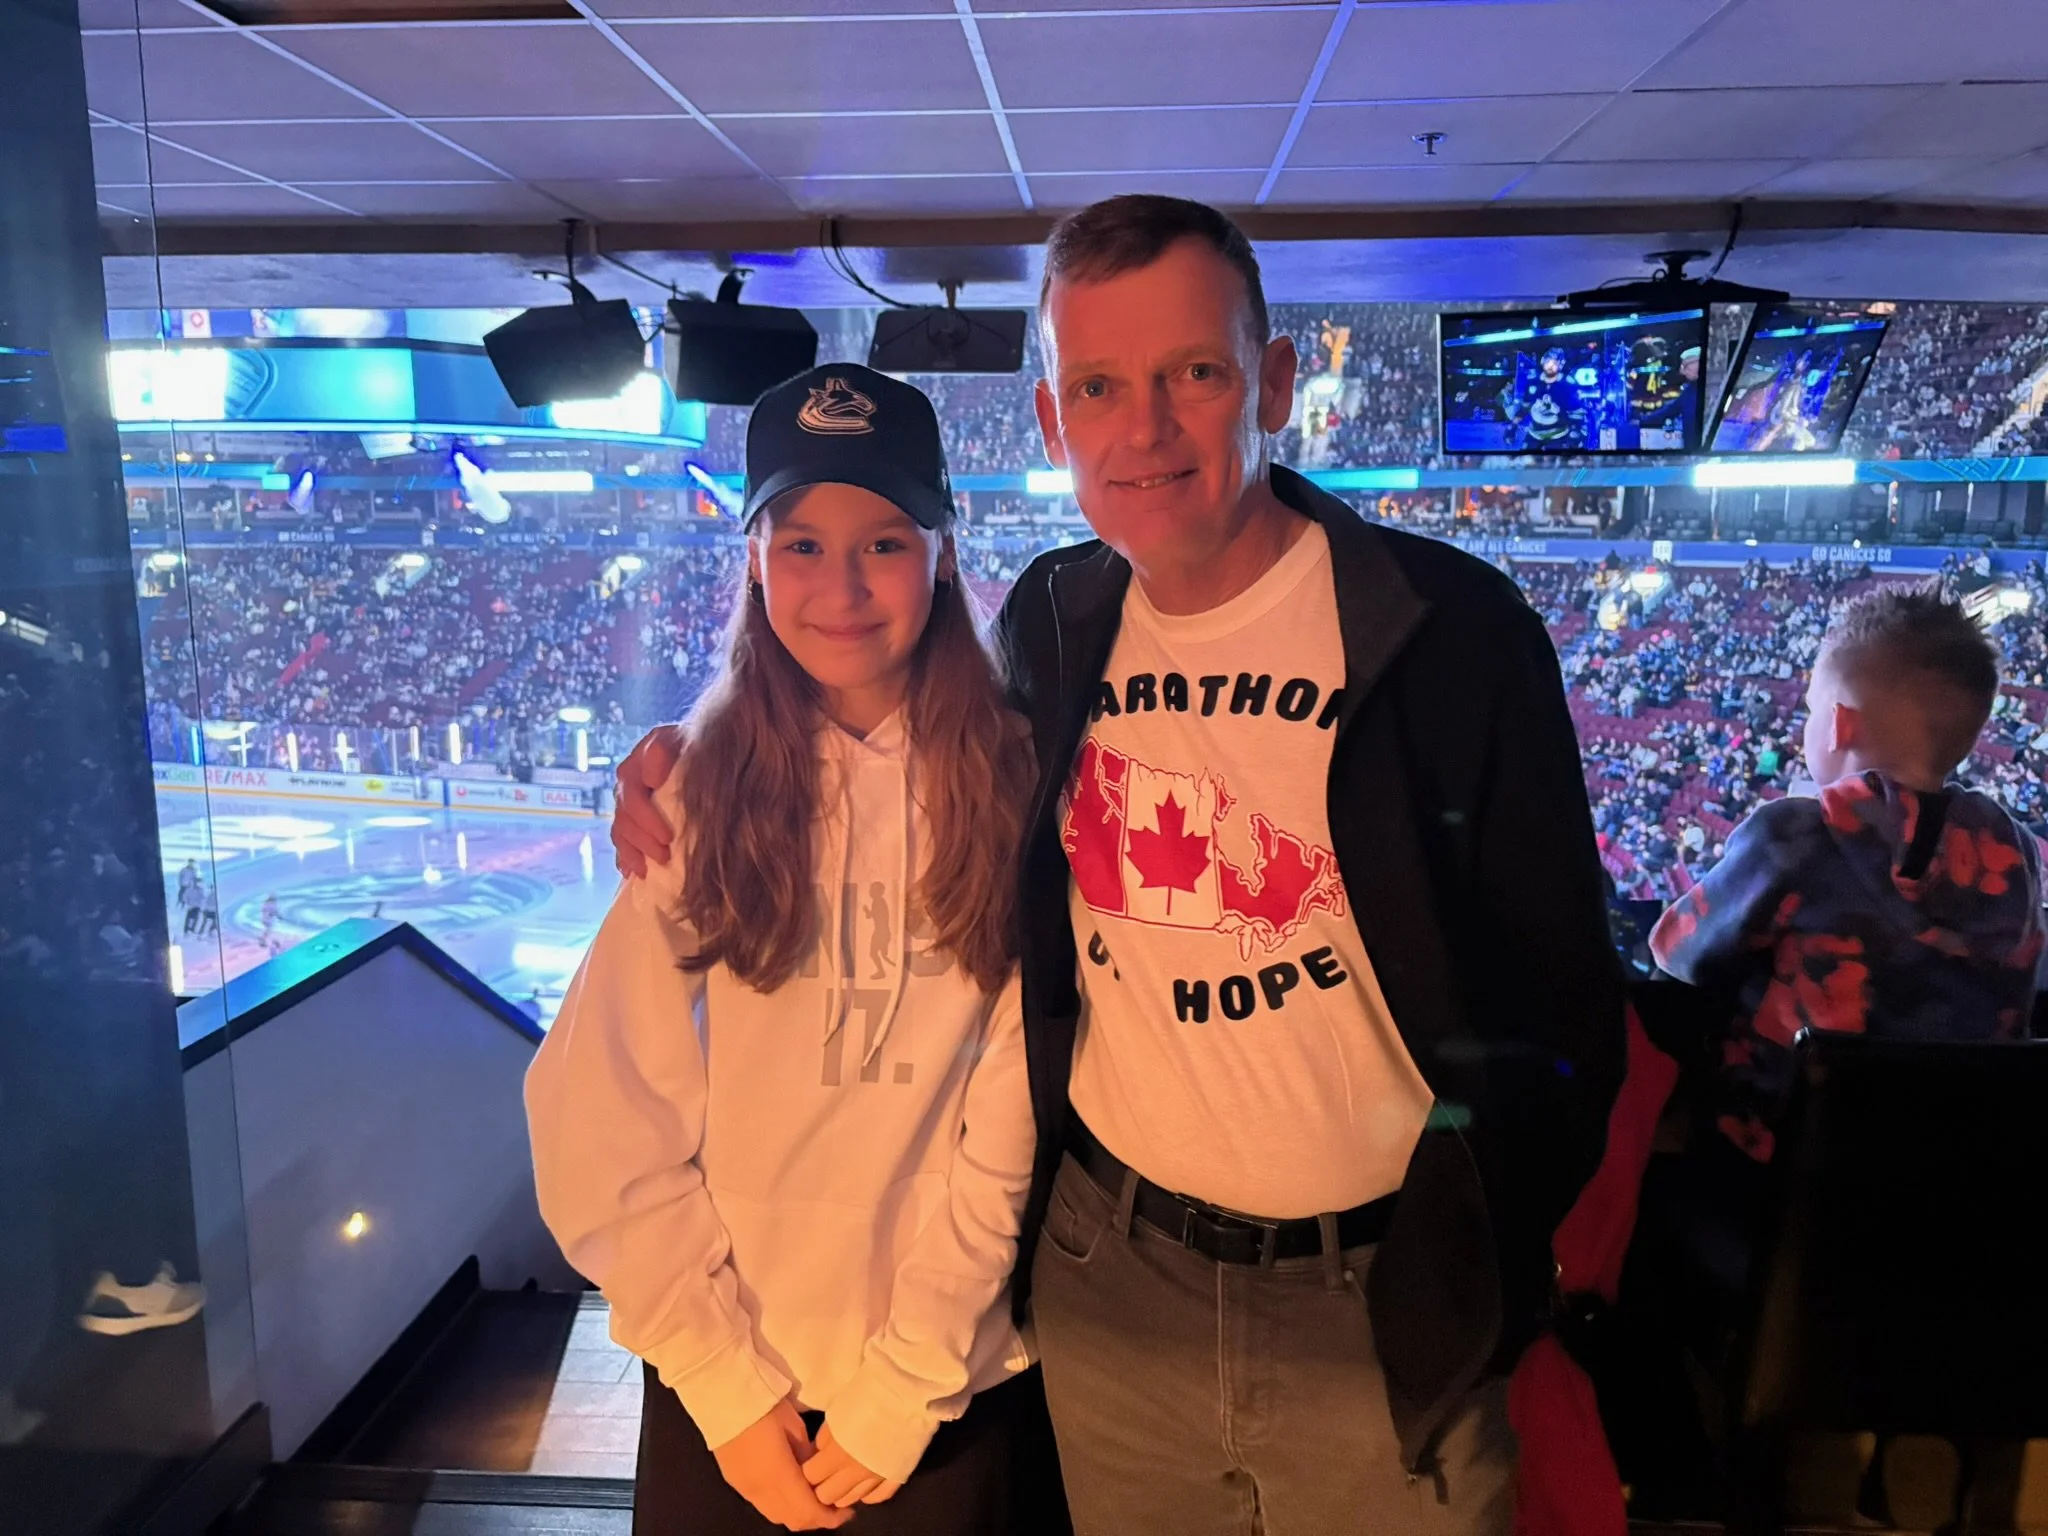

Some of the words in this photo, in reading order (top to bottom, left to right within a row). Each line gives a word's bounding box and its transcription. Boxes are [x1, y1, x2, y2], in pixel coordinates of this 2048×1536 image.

[1812, 546, 1827, 561] GO
[1829, 546, 1876, 562] CANUCKS
[206, 768, 267, 786] RE/MAX
[1173, 945, 1348, 1024] HOPE
